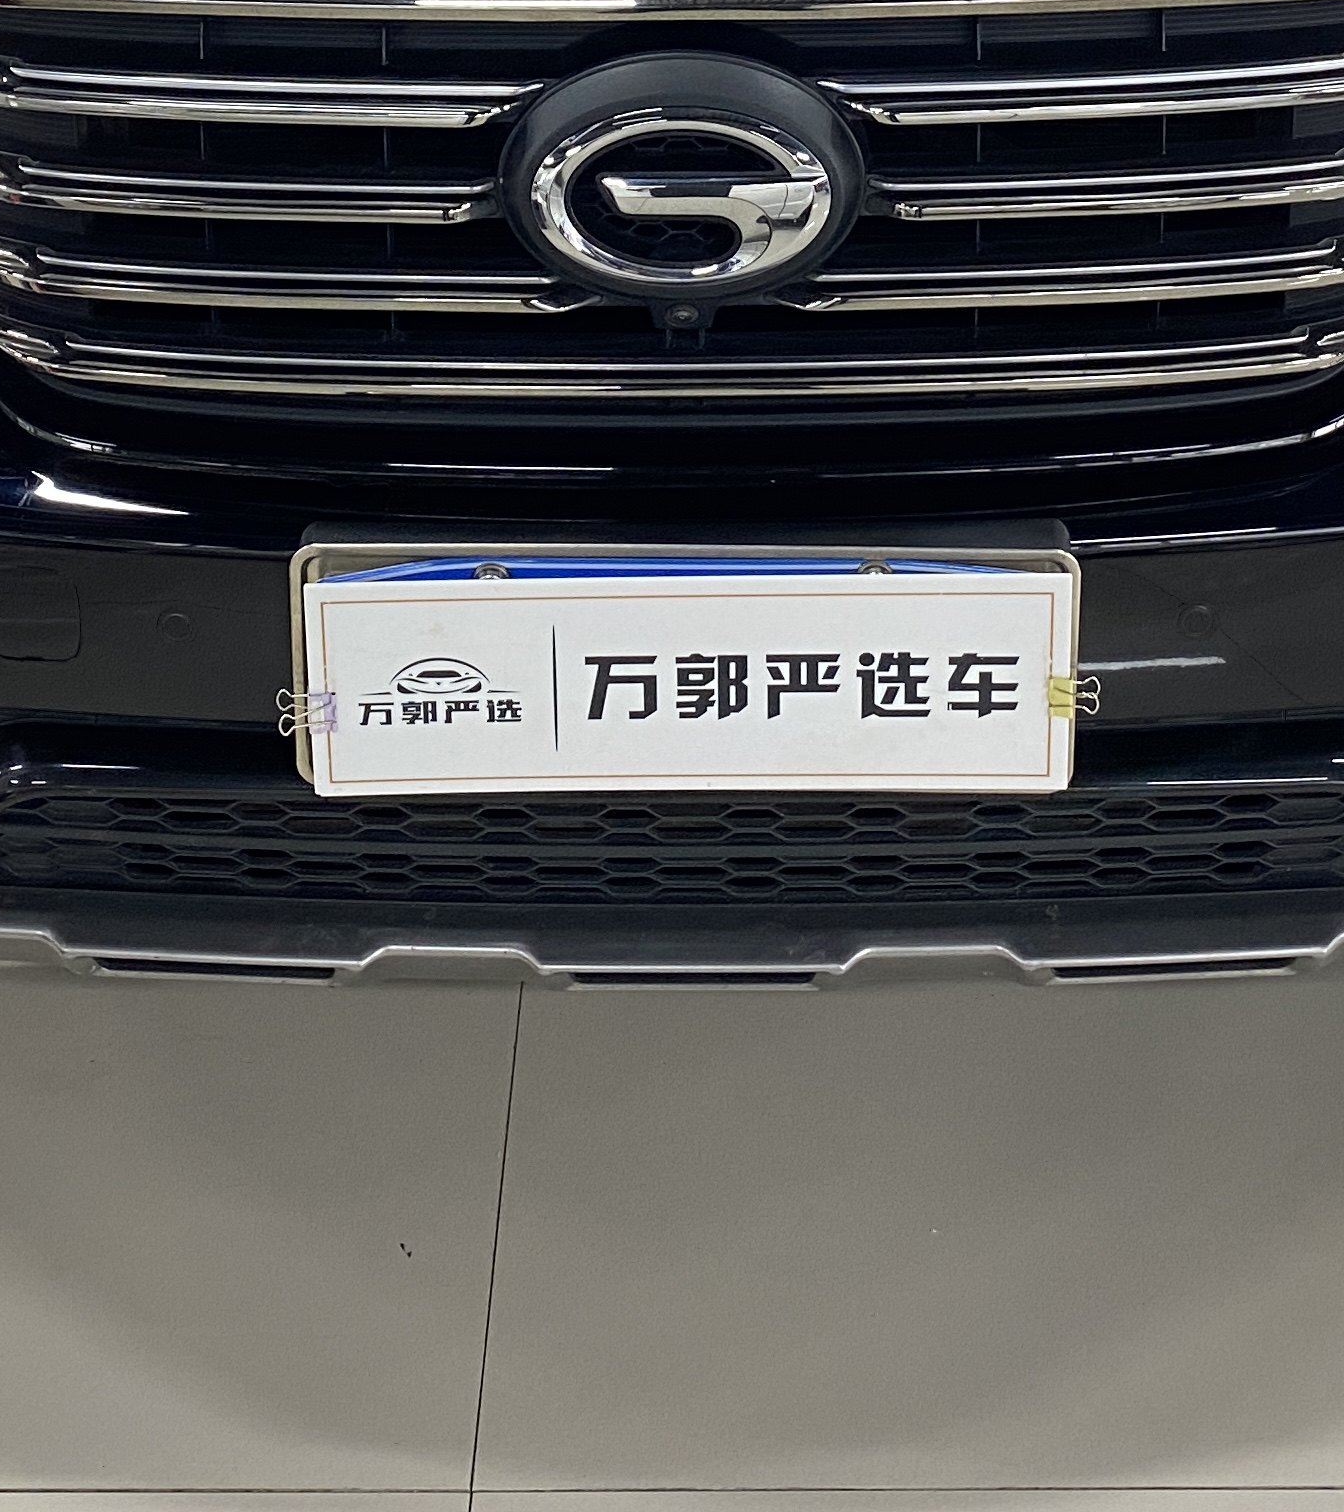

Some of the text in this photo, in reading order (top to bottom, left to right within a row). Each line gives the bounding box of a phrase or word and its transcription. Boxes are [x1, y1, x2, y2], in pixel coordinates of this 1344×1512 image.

[584, 651, 1020, 720] 万郭严选车
[358, 699, 522, 726] 万郭严选
